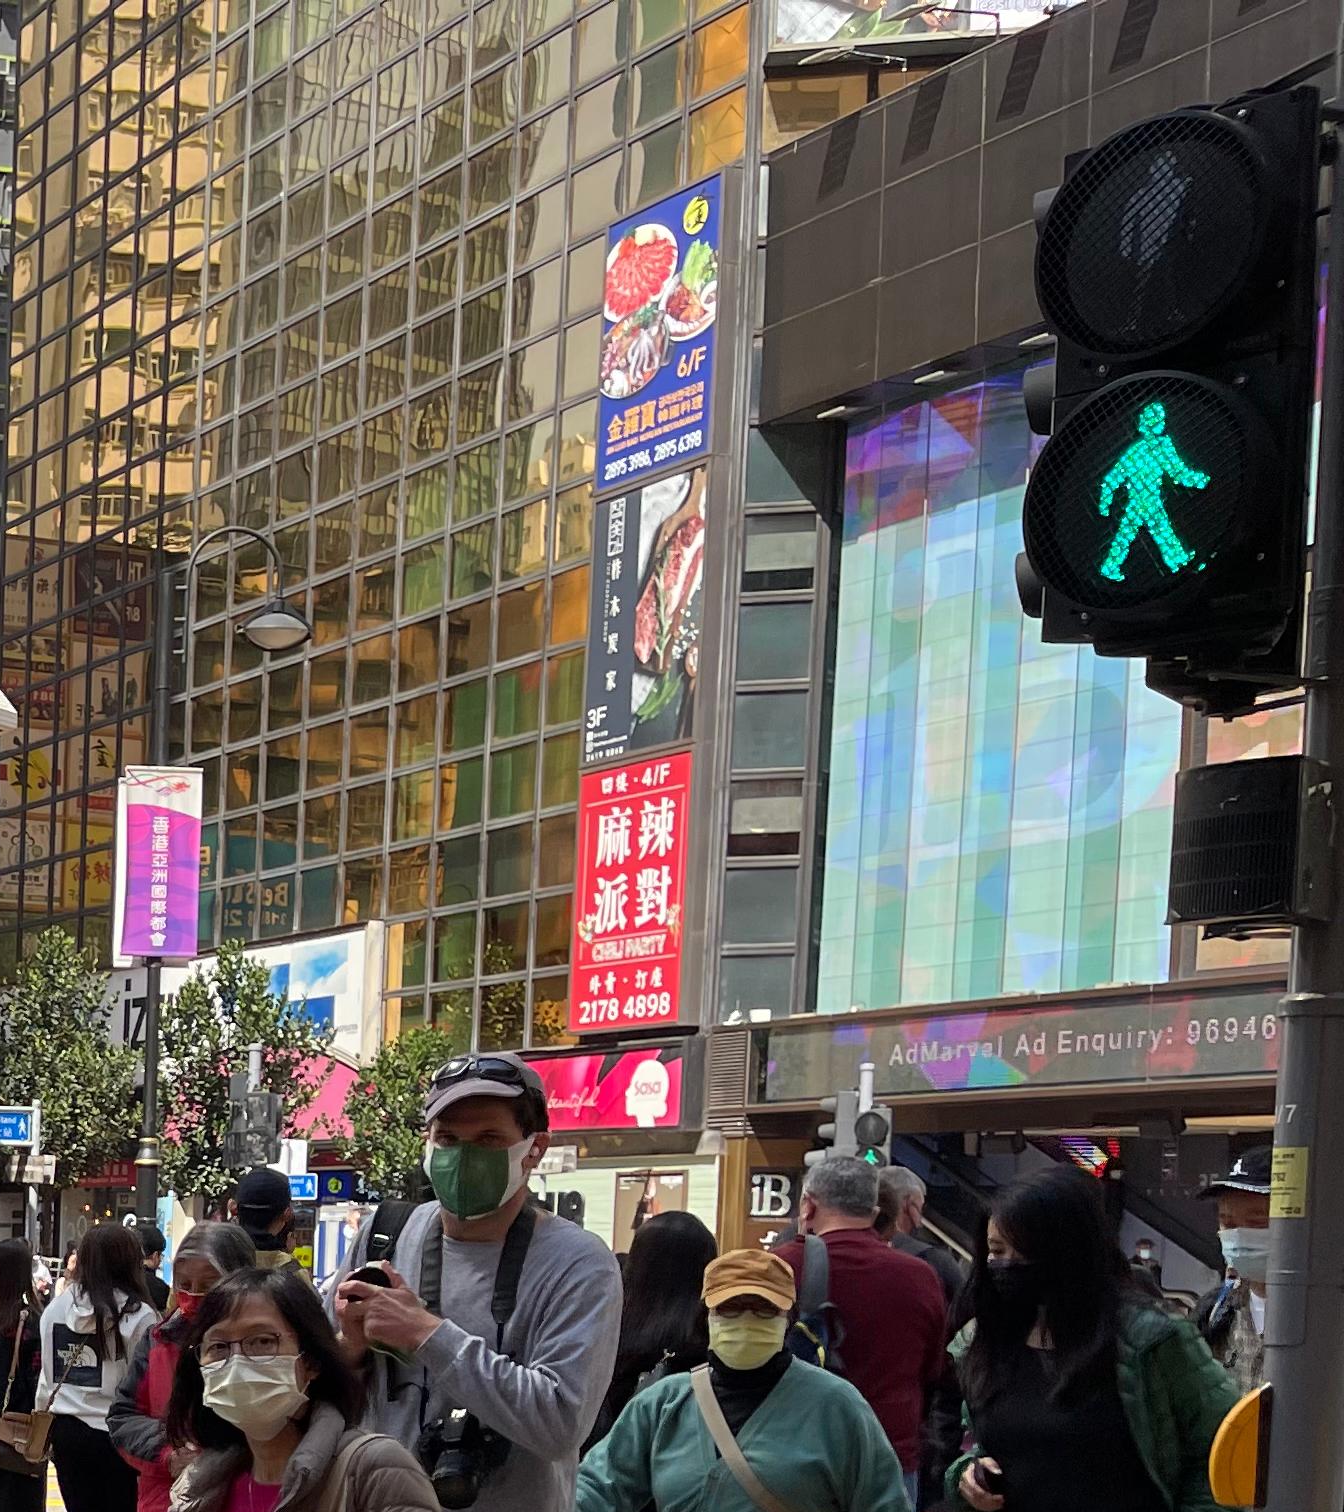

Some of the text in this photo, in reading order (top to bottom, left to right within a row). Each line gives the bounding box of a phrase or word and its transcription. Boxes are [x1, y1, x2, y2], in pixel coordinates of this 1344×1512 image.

[677, 346, 707, 378] 6/F
[586, 705, 608, 729] 3F
[642, 763, 672, 787] 4/F
[595, 797, 677, 868] 麻辣
[149, 816, 170, 947] 香港亞洲國際都會
[593, 865, 673, 935] 派對
[579, 991, 671, 1024] 2178 4898
[888, 1037, 1004, 1067] AdMarvel
[1014, 1032, 1046, 1057] Ad
[1056, 1023, 1175, 1059] Enquiry:
[749, 1173, 792, 1217] iB
